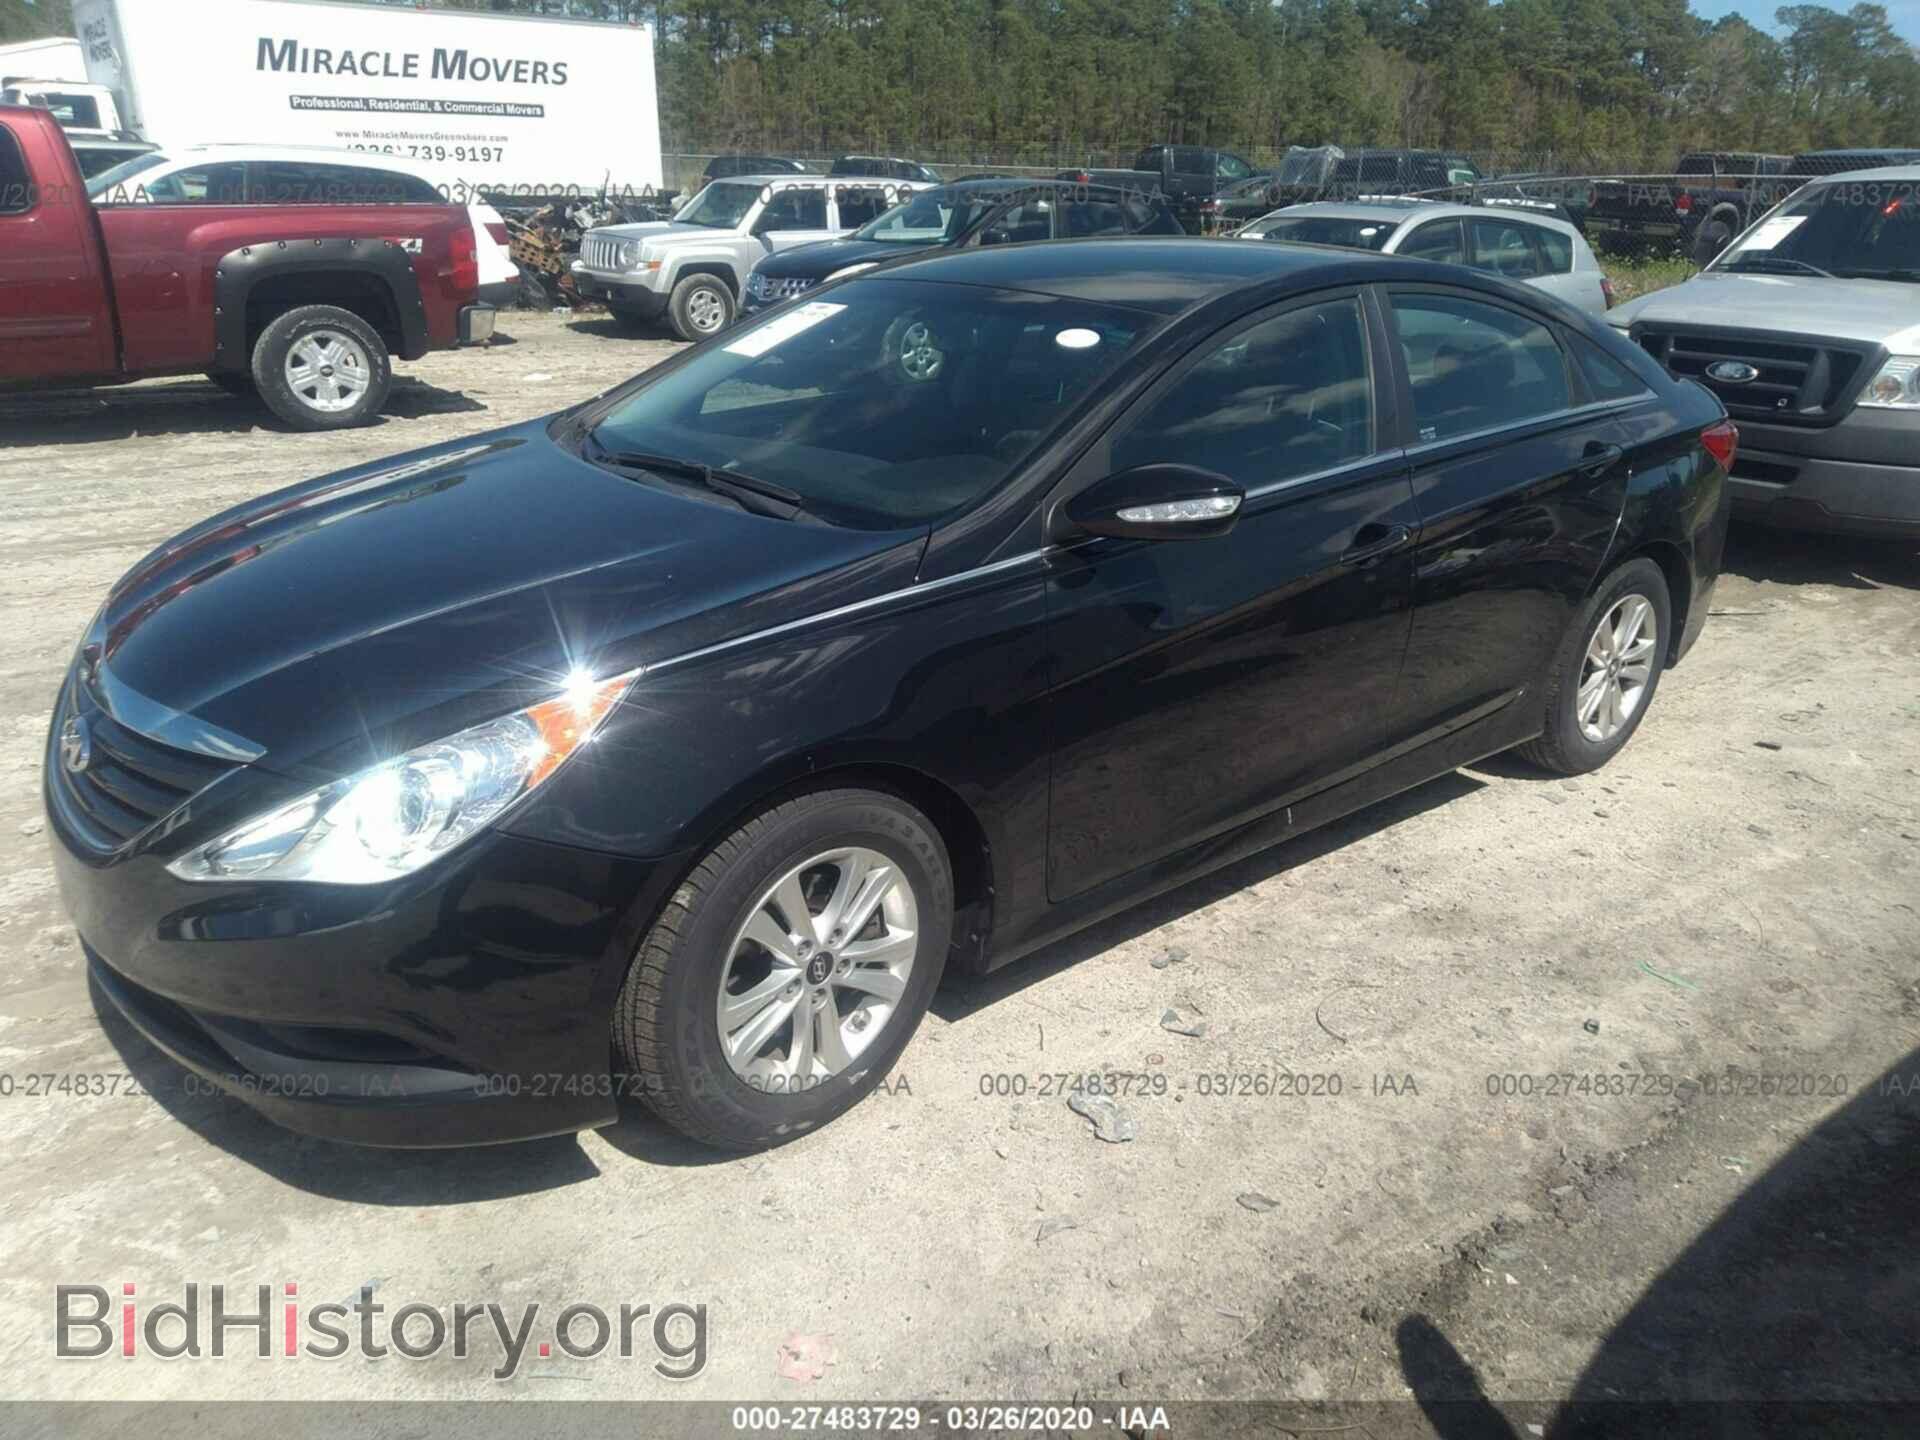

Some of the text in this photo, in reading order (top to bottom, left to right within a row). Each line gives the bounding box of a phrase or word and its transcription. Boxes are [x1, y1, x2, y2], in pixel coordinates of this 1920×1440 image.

[291, 95, 541, 116] Professional, Residential, & Commercial Movers
[408, 144, 504, 163] 739-9197
